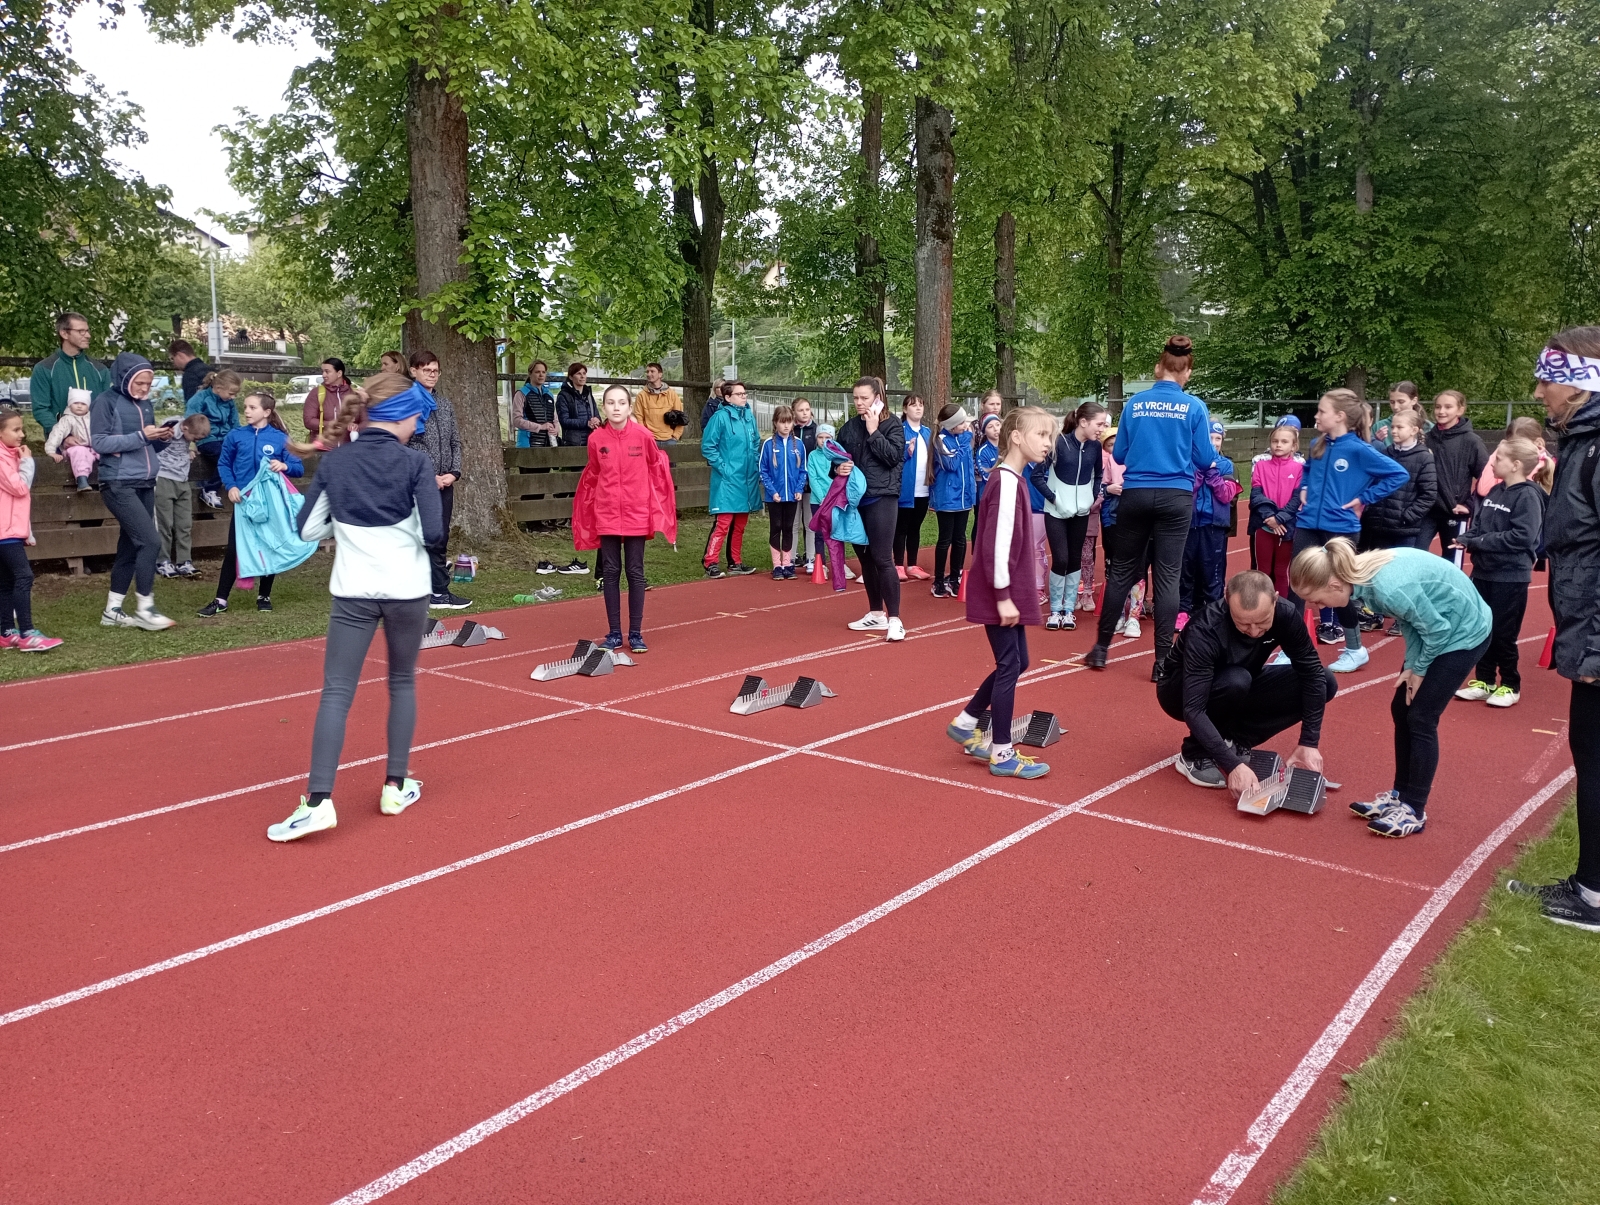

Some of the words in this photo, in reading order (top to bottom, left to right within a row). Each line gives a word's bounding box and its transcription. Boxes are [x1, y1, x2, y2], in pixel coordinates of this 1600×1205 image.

[1133, 402, 1144, 411] SK
[1145, 401, 1190, 413] VRCHLABÍ
[1149, 411, 1187, 421] KONSTRUKCE
